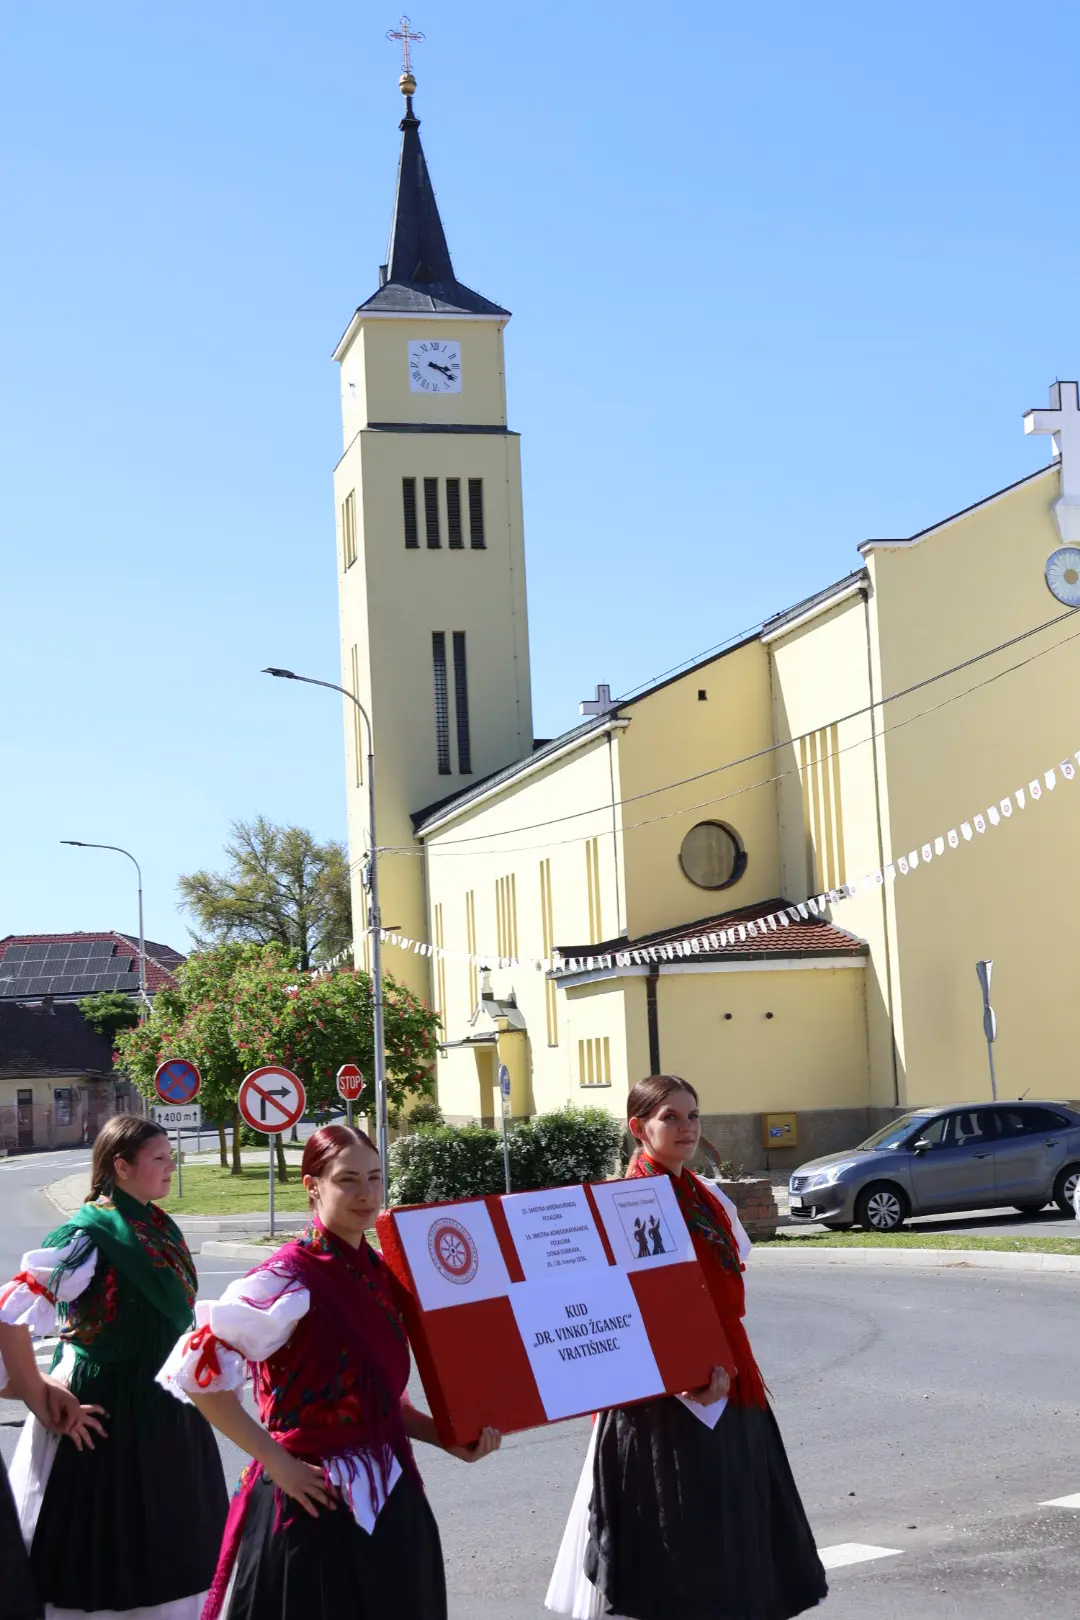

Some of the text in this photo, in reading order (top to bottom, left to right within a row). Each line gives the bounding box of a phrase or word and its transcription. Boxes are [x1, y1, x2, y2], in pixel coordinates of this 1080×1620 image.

[340, 1075, 360, 1090] STOP
[164, 1112, 182, 1122] 400
[565, 1303, 588, 1318] KUD
[555, 1323, 589, 1341] VINKO
[558, 1337, 620, 1362] VRATIŠINEC
